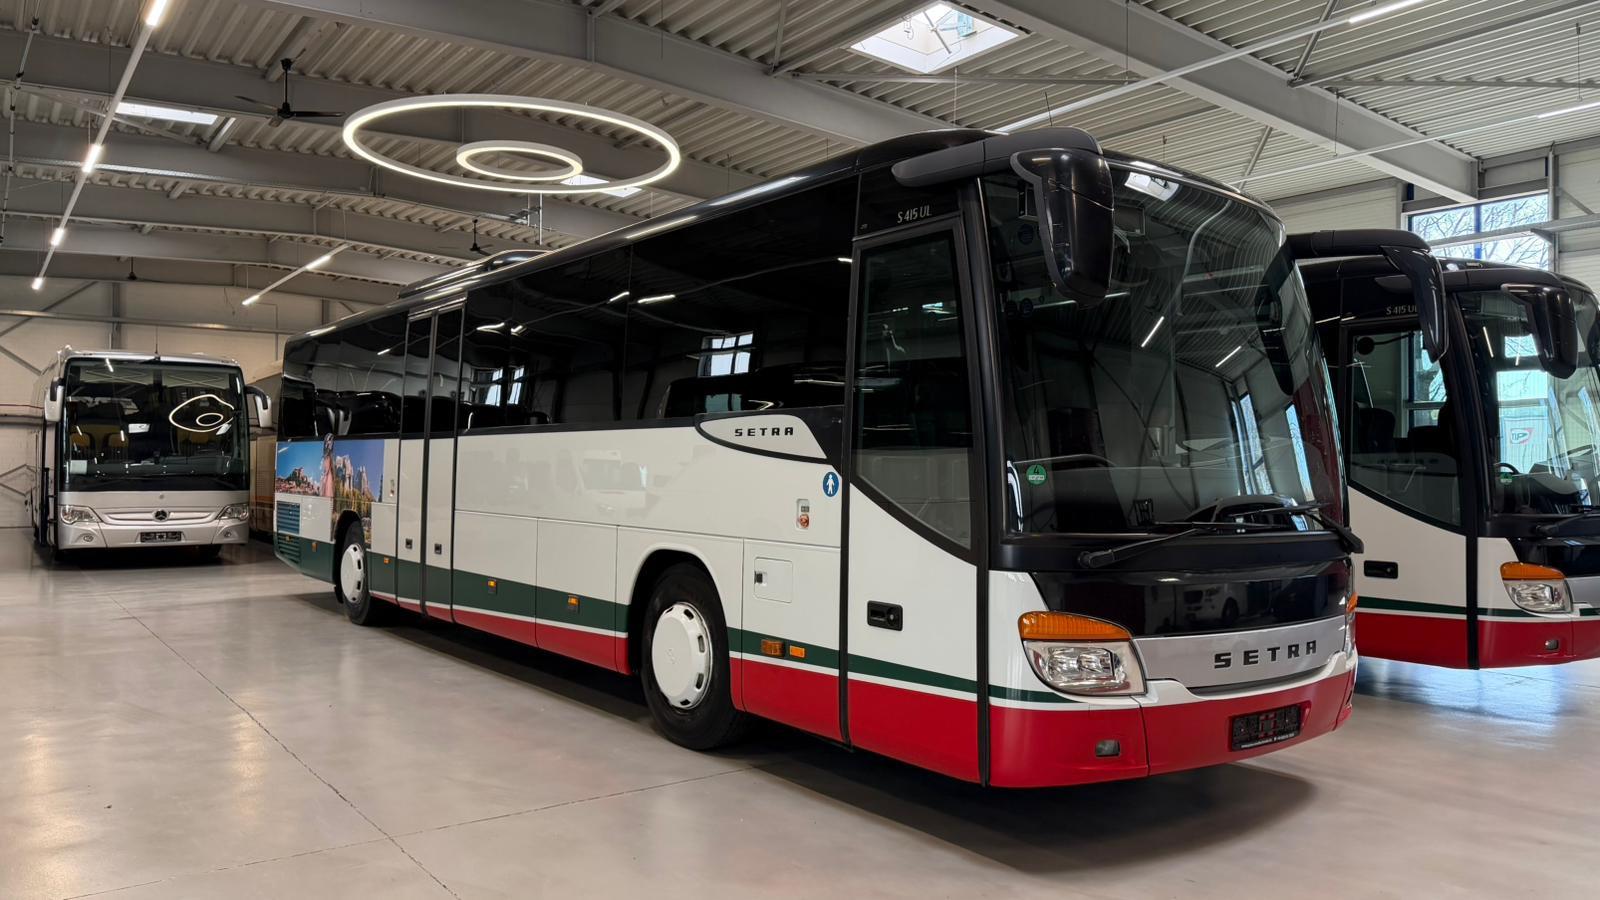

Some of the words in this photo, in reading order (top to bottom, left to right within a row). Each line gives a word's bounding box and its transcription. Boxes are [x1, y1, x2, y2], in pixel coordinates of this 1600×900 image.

[897, 211, 903, 224] S
[904, 207, 918, 221] 415
[919, 204, 932, 218] UL
[1385, 306, 1392, 315] S
[1392, 305, 1406, 315] 415
[734, 426, 794, 437] SETRA
[1214, 639, 1317, 670] SETRA
